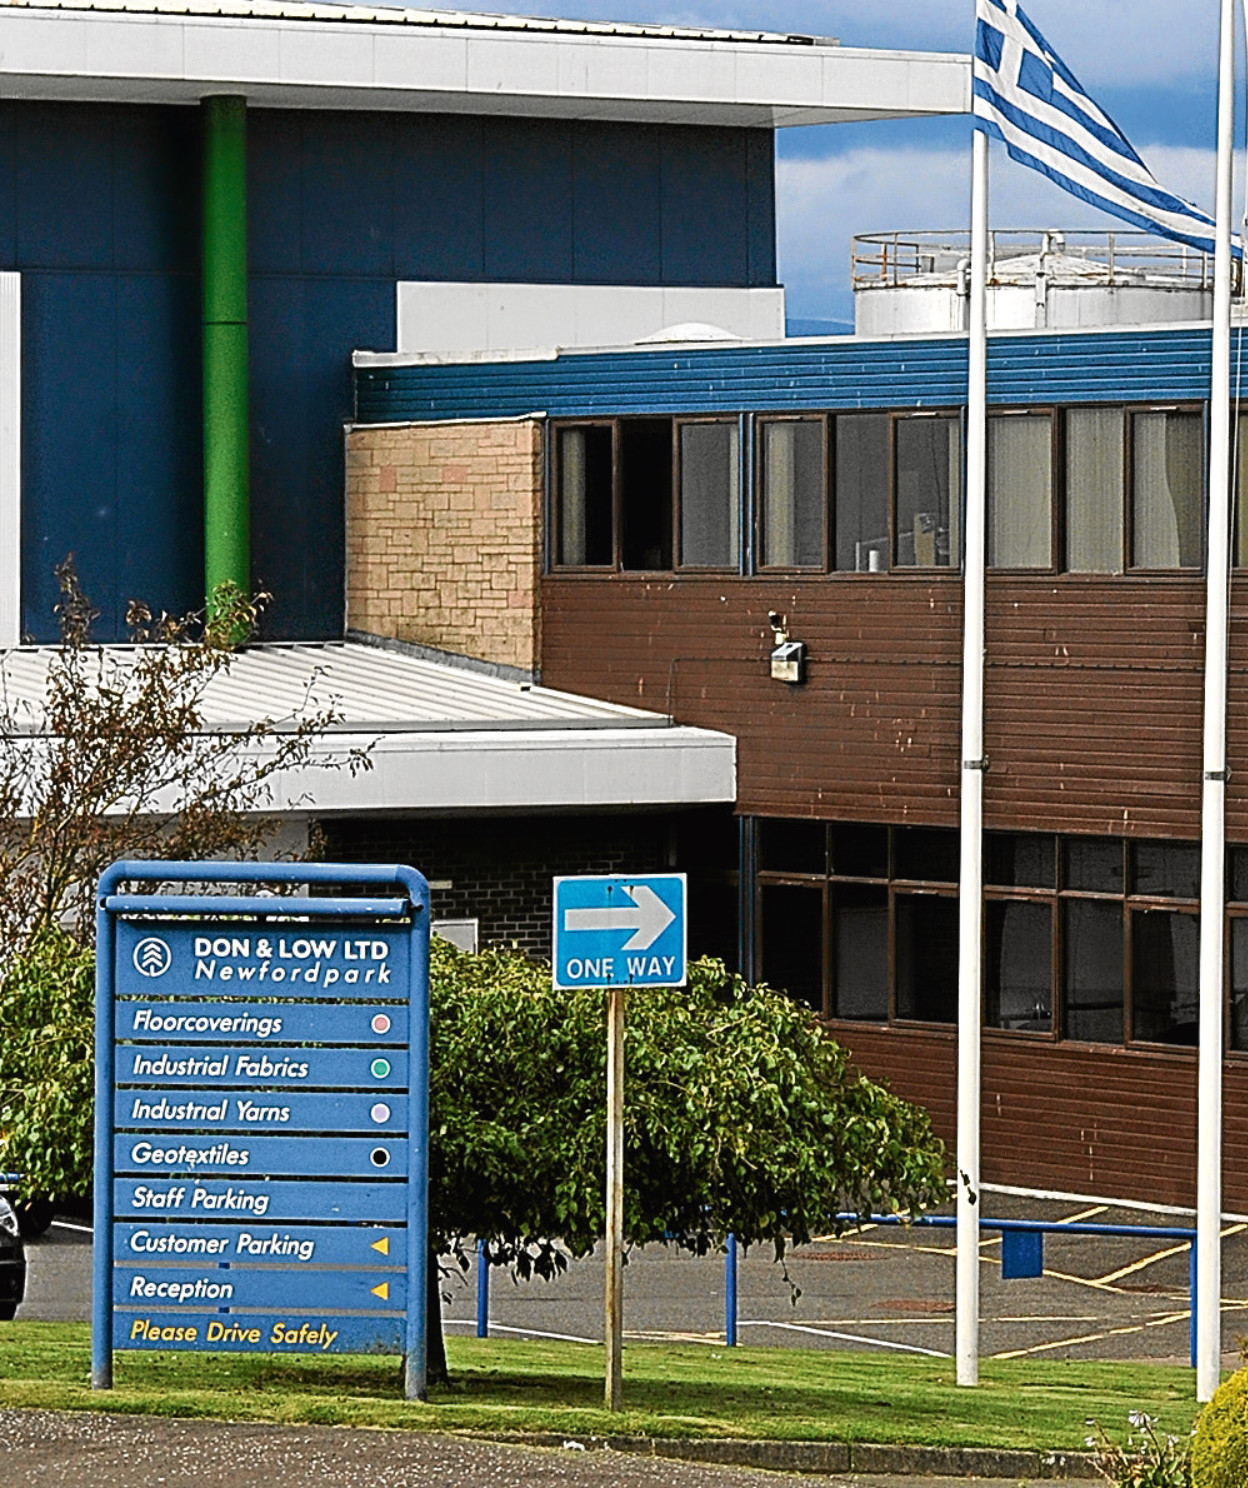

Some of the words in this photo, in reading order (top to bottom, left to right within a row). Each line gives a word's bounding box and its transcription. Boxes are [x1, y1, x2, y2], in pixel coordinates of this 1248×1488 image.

[194, 937, 250, 959] DON
[255, 938, 273, 959] &
[279, 939, 337, 960] LOW
[344, 940, 388, 961] LTD
[194, 959, 391, 986] Newfordpark
[567, 957, 615, 979] ONE
[627, 955, 675, 977] WAY
[132, 1009, 282, 1035] Floorcoverings
[132, 1054, 228, 1077] Industrial
[234, 1054, 308, 1078] Fabrics
[132, 1098, 226, 1121] Industrial
[236, 1100, 291, 1122] Yarns
[131, 1143, 249, 1166] Geotextiles
[132, 1186, 187, 1209] Staff
[192, 1189, 269, 1214] Parking
[130, 1231, 228, 1255] Customer
[237, 1233, 314, 1260] Parking
[130, 1276, 233, 1302] Reception
[130, 1320, 197, 1342] Please
[207, 1321, 260, 1344] Drive
[270, 1321, 338, 1351] Safely
